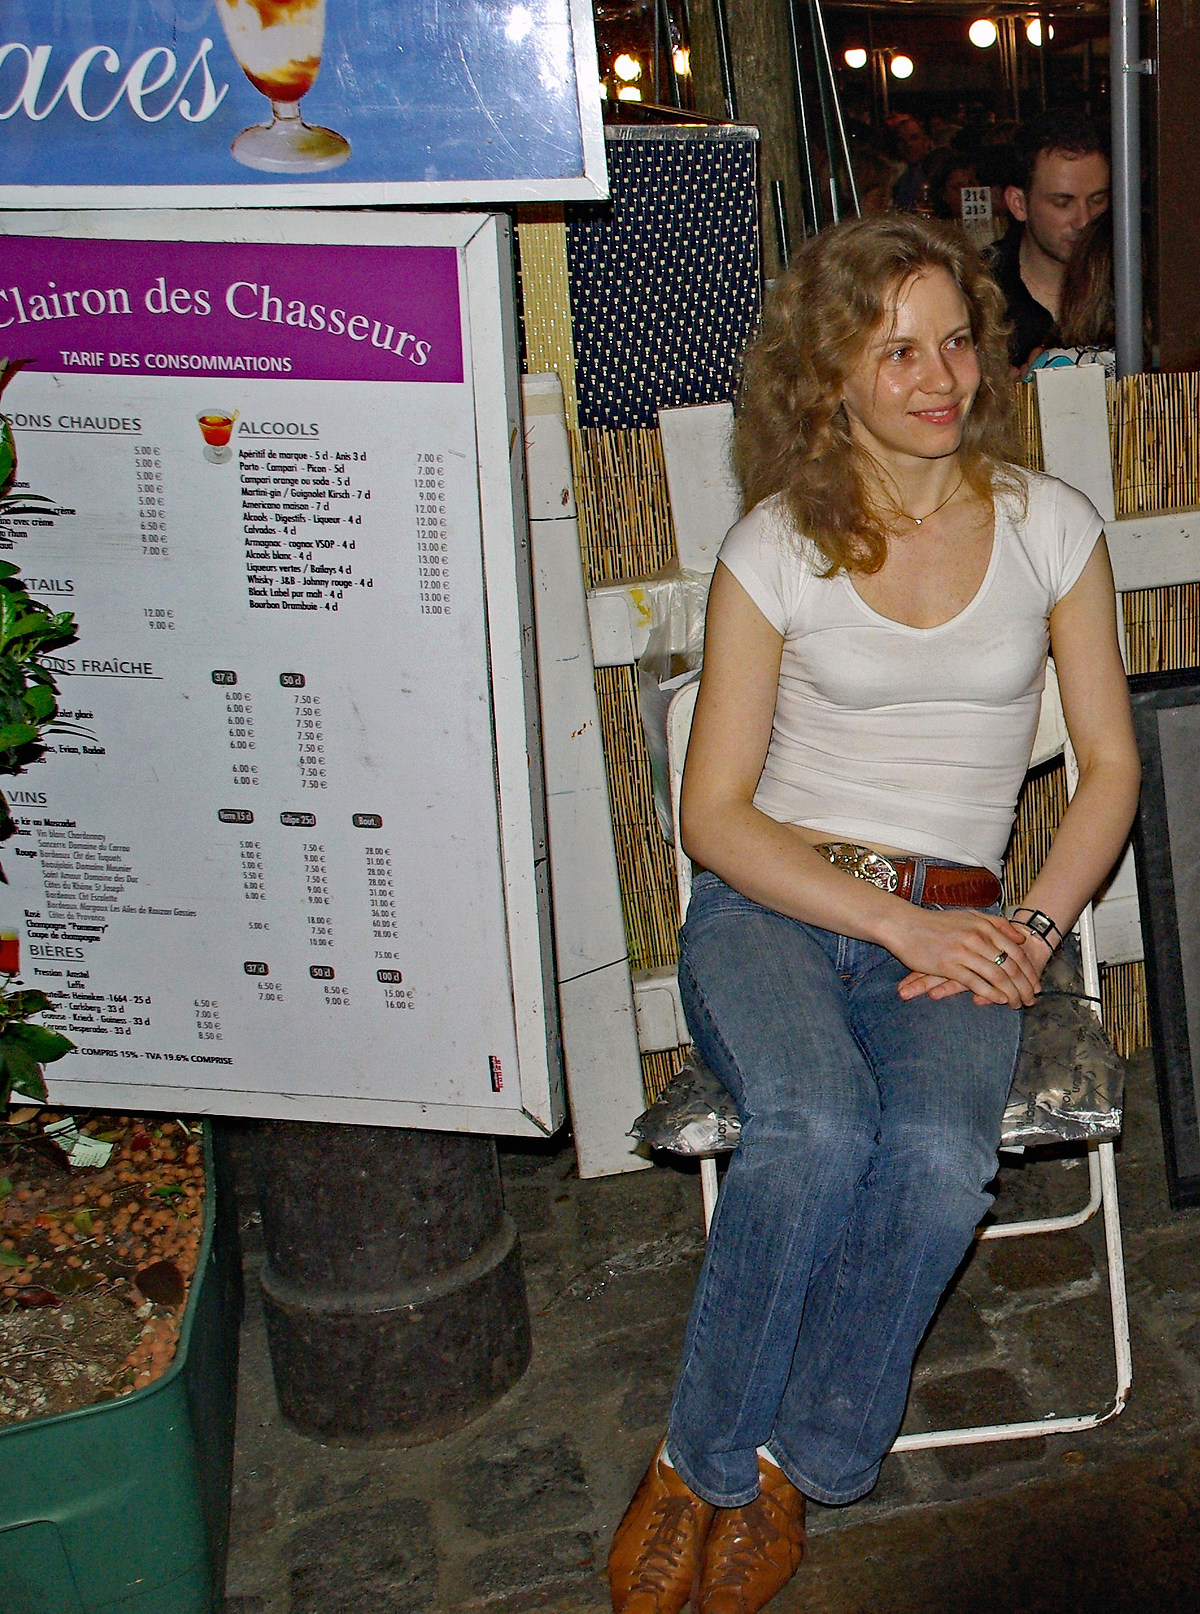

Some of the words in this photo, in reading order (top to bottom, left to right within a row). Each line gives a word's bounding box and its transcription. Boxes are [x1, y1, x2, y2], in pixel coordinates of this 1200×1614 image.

[0, 38, 229, 122] aces
[964, 190, 986, 201] 214
[0, 281, 132, 329] Clairon
[145, 277, 212, 316] des
[225, 281, 432, 366] Chasseurs
[60, 351, 104, 367] TARIF
[110, 352, 139, 367] DES
[145, 354, 292, 372] CONSOMMATIONS
[5, 413, 52, 427] SONS
[59, 416, 141, 430] CHAUDES
[239, 422, 319, 435] ALCOOLS
[239, 449, 265, 460] Apéritif
[268, 450, 277, 458] de
[279, 453, 307, 461] marque
[336, 452, 351, 460] Anis
[417, 454, 434, 462] 7.00
[240, 462, 259, 471] Porto
[267, 463, 297, 473] Campari
[418, 466, 435, 475] 7.00
[240, 475, 271, 485] Campari
[273, 478, 298, 487] orange
[312, 477, 329, 485] soda
[415, 479, 435, 488] 12.00
[328, 489, 350, 498] Kirsch
[419, 492, 436, 501] 9.00
[242, 500, 280, 509] Americano
[283, 502, 309, 510] maison
[416, 505, 437, 513] 12.00
[243, 512, 268, 521] Alcools
[416, 517, 437, 526] 12.00
[417, 530, 438, 539] 12.00
[315, 540, 335, 548] VSOP
[418, 543, 439, 551] 13.00
[246, 550, 270, 559] Alcools
[418, 555, 439, 564] 13.00
[419, 568, 440, 576] 12.00
[247, 575, 273, 586] Whisky
[281, 576, 295, 585] J&B
[303, 576, 329, 588] Johnny
[331, 580, 352, 588] rouge
[420, 580, 441, 589] 12.00
[248, 587, 268, 596] Black
[270, 588, 289, 597] Label
[420, 593, 441, 601] 13.00
[249, 600, 280, 609] Bourbon
[421, 605, 442, 614] 13.00
[82, 658, 153, 674] FRAÎCHE
[283, 676, 293, 684] 50
[226, 692, 242, 700] 6.00
[294, 695, 311, 704] 7.50
[227, 704, 243, 712] 6.00
[296, 707, 312, 716] 7.50
[228, 717, 244, 725] 6.00
[296, 719, 313, 728] 7.50
[229, 729, 245, 737] 6.00
[298, 732, 314, 740] 7.50
[230, 741, 247, 749] 6.00
[299, 744, 315, 752] 7.50
[300, 756, 316, 764] 6.00
[233, 764, 249, 772] 6.00
[301, 767, 317, 776] 7.50
[302, 780, 318, 788] 7.50
[7, 791, 46, 803] VINS
[30, 942, 84, 958] BIÈRES
[384, 989, 405, 998] 15.00
[325, 997, 341, 1005] 9.00
[386, 1001, 406, 1009] 16.00
[133, 1017, 143, 1025] 33
[81, 1048, 118, 1057] COMPRIS
[145, 1052, 162, 1060] TVA
[191, 1055, 233, 1065] COMPRISE
